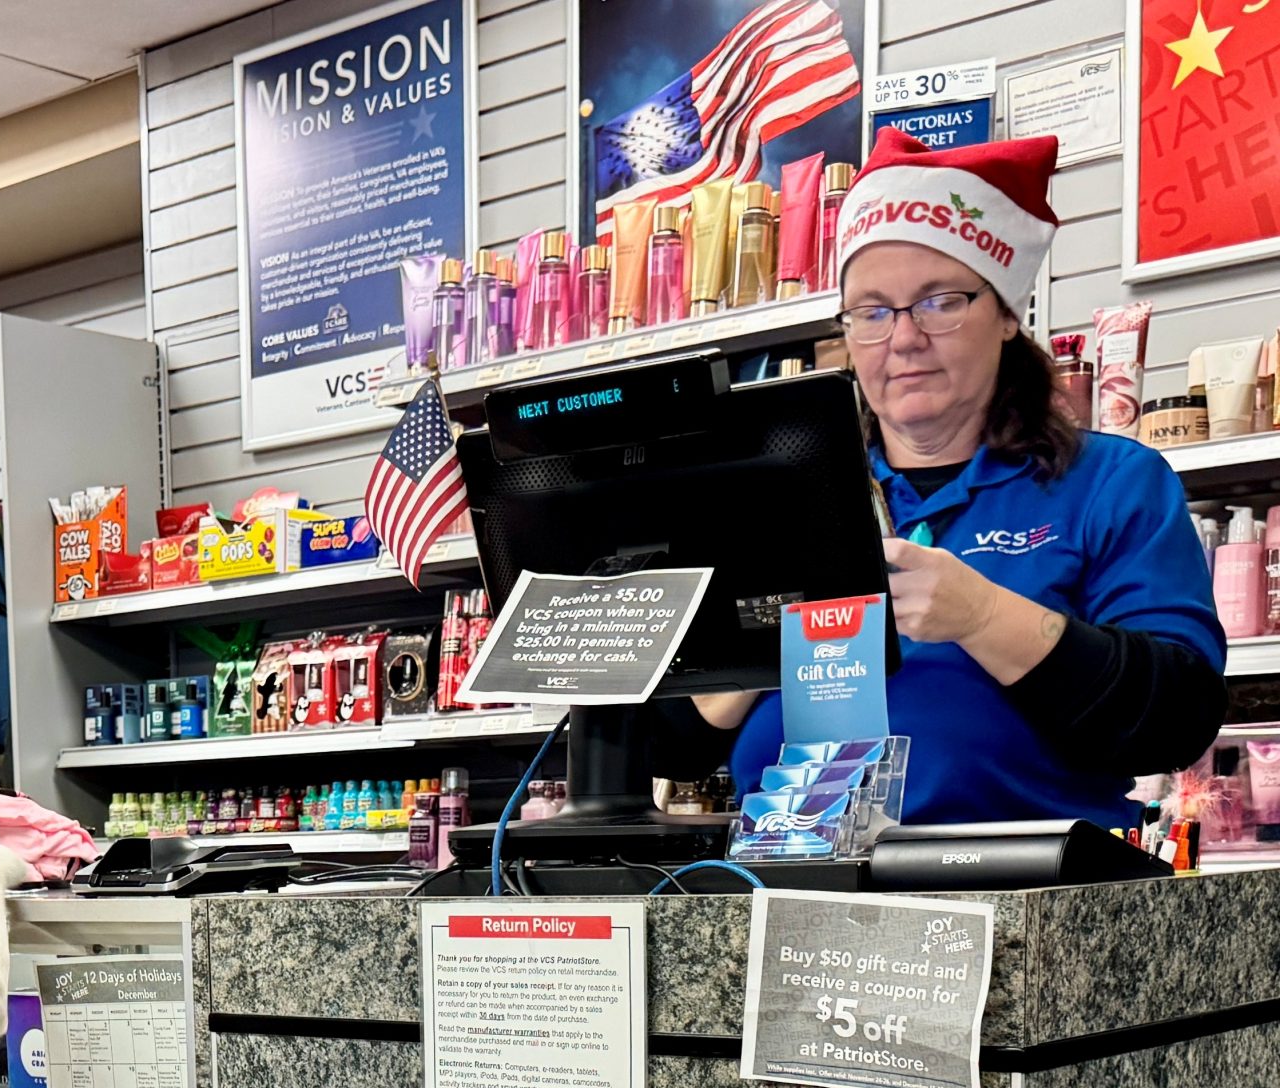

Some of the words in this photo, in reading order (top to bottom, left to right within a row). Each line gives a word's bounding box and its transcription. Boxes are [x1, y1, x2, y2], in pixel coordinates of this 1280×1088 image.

[257, 18, 450, 119] MISSION
[875, 93, 890, 102] UP
[895, 90, 908, 100] TO
[915, 70, 959, 96] 30%
[876, 78, 906, 91] SAVE
[280, 110, 330, 142] SION
[341, 103, 355, 124] &
[365, 73, 452, 117] VALUES
[891, 110, 973, 131] VICTORIA'S
[915, 131, 957, 146] CRET
[261, 330, 285, 348] CORE
[286, 325, 319, 341] VALUES
[326, 372, 366, 398] VCS
[518, 401, 548, 419] NEXT
[557, 388, 622, 412] CUSTOMER
[1150, 425, 1191, 439] HONEY
[313, 520, 345, 537] SUPER
[60, 530, 89, 546] COW
[976, 530, 1027, 546] VCS
[60, 544, 90, 560] TALES
[221, 541, 253, 562] POPS
[549, 593, 600, 607] Receive
[602, 594, 611, 602] a
[615, 588, 664, 603] $5.00
[523, 609, 553, 620] VCS
[554, 607, 602, 621] coupon
[607, 607, 646, 617] when
[648, 609, 676, 620] you
[810, 606, 854, 629] NEW
[516, 622, 553, 636] bring
[555, 622, 568, 633] in
[570, 623, 580, 632] a
[583, 622, 646, 633] minimum
[650, 620, 668, 633] of
[513, 636, 561, 648] $25.00
[563, 636, 576, 647] in
[577, 637, 634, 649] pennies
[638, 637, 653, 648] to
[512, 652, 576, 664] exchange
[580, 651, 601, 662] for
[604, 652, 638, 662] cash.
[797, 665, 823, 681] Gift
[827, 661, 867, 678] Cards
[546, 676, 569, 686] VCS
[754, 816, 797, 832] VCS
[941, 853, 981, 865] EPSON
[482, 917, 529, 932] Return
[533, 920, 576, 936] Policy
[924, 917, 953, 936] JOY
[931, 930, 968, 946] STARTS
[945, 940, 973, 953] HERE
[459, 956, 471, 964] you
[485, 956, 517, 965] shopping
[780, 946, 815, 965] Buy
[820, 948, 852, 968] $50
[857, 955, 887, 973] gift
[891, 958, 929, 976] card
[934, 964, 968, 981] and
[83, 972, 96, 983] 12
[99, 971, 124, 986] Days
[127, 969, 137, 982] of
[139, 969, 182, 985] Holidays
[528, 967, 546, 976] policy
[55, 972, 73, 989] JOY
[467, 981, 482, 990] copy
[531, 983, 555, 991] receipt.
[783, 972, 845, 990] receive
[850, 981, 859, 992] a
[865, 982, 926, 1000] coupon
[932, 985, 960, 1004] for
[72, 987, 89, 1000] HERE
[118, 990, 156, 999] December
[489, 1012, 505, 1021] days
[816, 994, 858, 1038] $5
[864, 1014, 908, 1045] off
[468, 1026, 512, 1035] manufacturer
[514, 1028, 550, 1037] warranties
[439, 1059, 472, 1068] Electronic
[475, 1061, 502, 1070] Returns:
[800, 1044, 818, 1057] at
[823, 1043, 929, 1073] PatriotStore.
